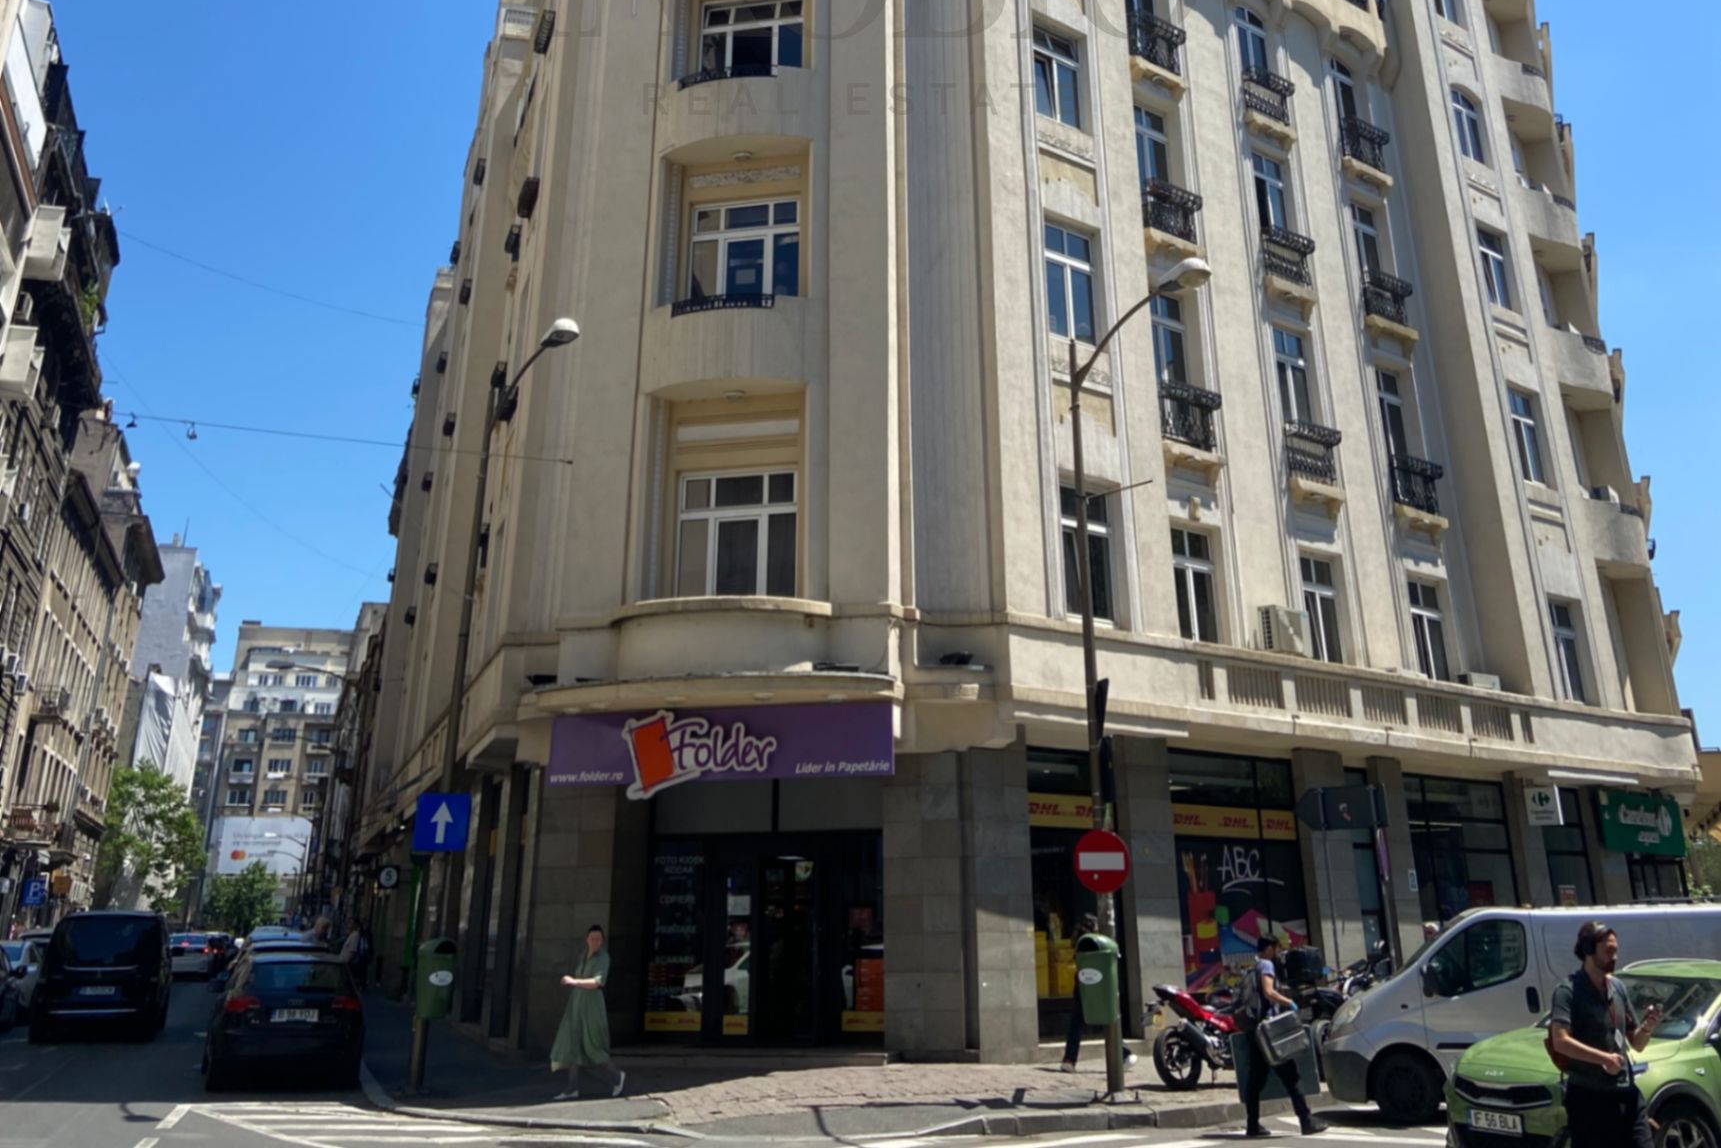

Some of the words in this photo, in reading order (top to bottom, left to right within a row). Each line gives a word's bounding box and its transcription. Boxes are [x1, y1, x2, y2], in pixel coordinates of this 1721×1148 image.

[661, 718, 777, 773] Folder
[795, 760, 823, 775] Lider
[549, 769, 625, 784] www.folder.ro
[1027, 801, 1061, 817] DHL
[1075, 804, 1095, 819] DH
[1173, 813, 1204, 827] DHL
[1220, 816, 1251, 829] DHL
[1264, 818, 1293, 831] DHL
[1217, 844, 1260, 883] ABC
[29, 882, 41, 899] P
